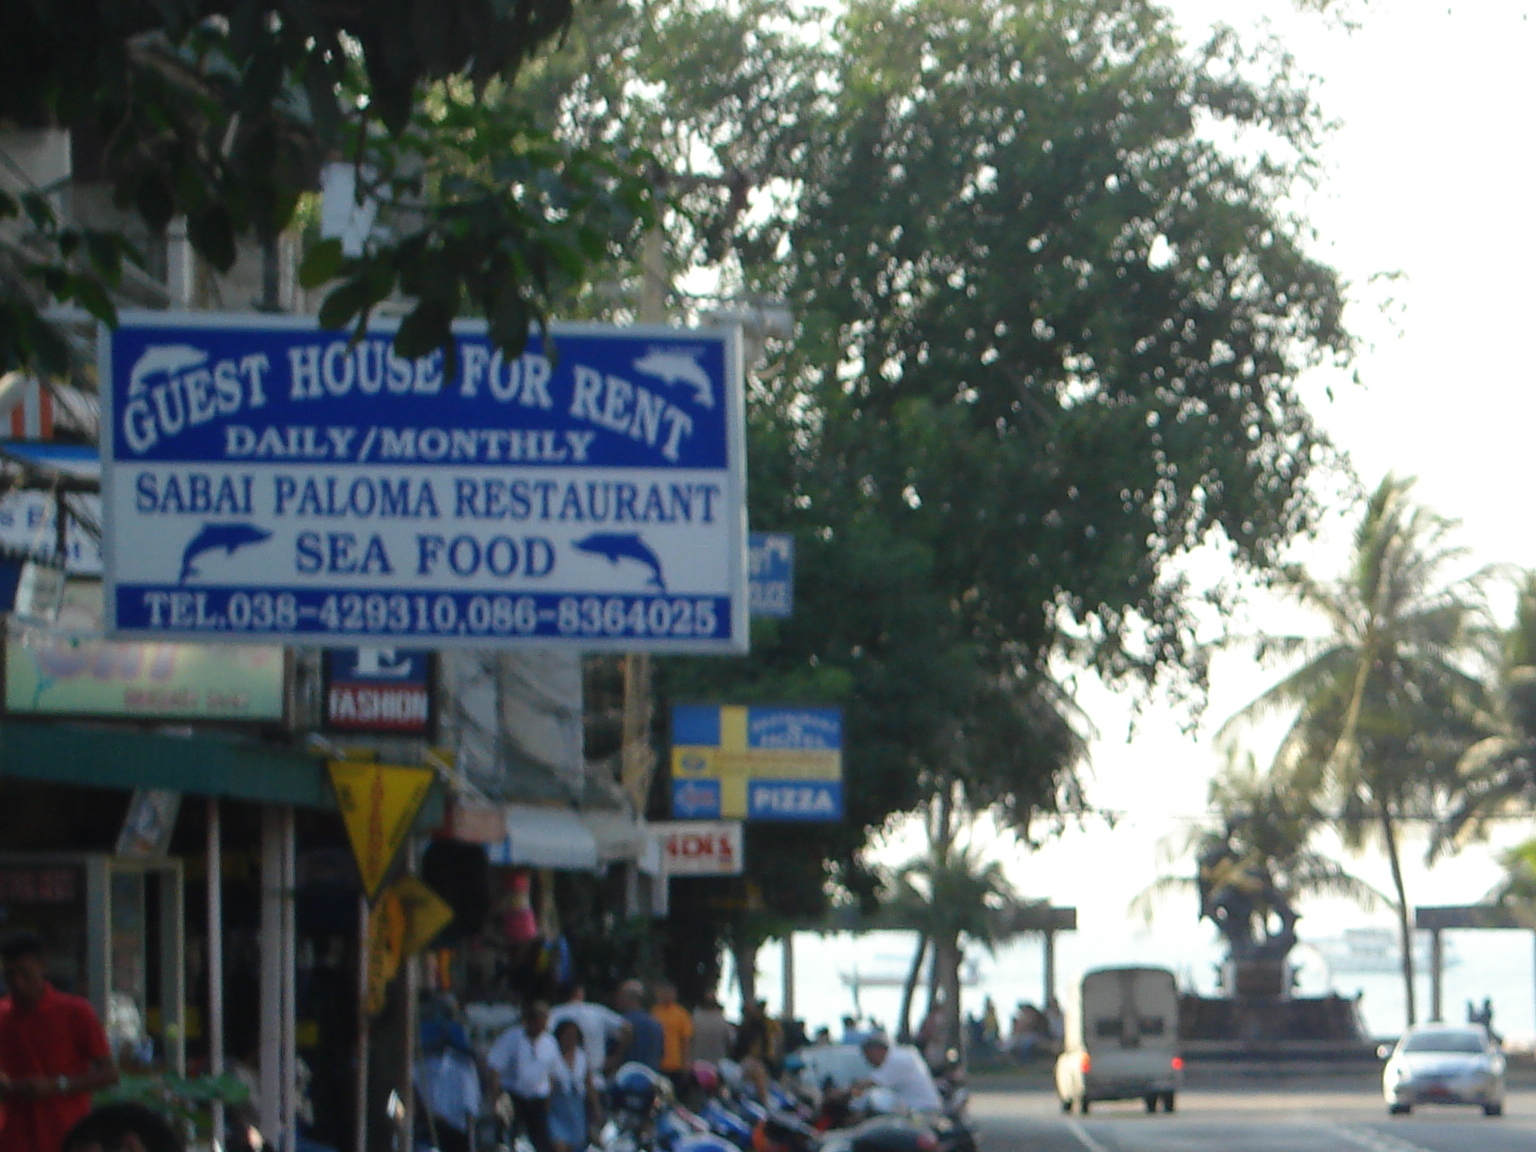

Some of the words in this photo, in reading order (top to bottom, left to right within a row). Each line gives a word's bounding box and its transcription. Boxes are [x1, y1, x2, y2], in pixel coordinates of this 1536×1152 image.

[123, 353, 270, 454] GUEST
[287, 340, 442, 401] HOUSE
[460, 344, 553, 410] FOR
[569, 364, 693, 463] RENT
[224, 425, 595, 464] DAILY/MONTHLY
[135, 472, 255, 514] SABAI
[274, 475, 440, 518] PALOMA
[455, 478, 720, 523] RESTAURANT
[296, 531, 394, 576] SEA
[416, 533, 556, 578] FOOD
[329, 687, 428, 722] FASHION
[753, 786, 834, 814] PIZZA
